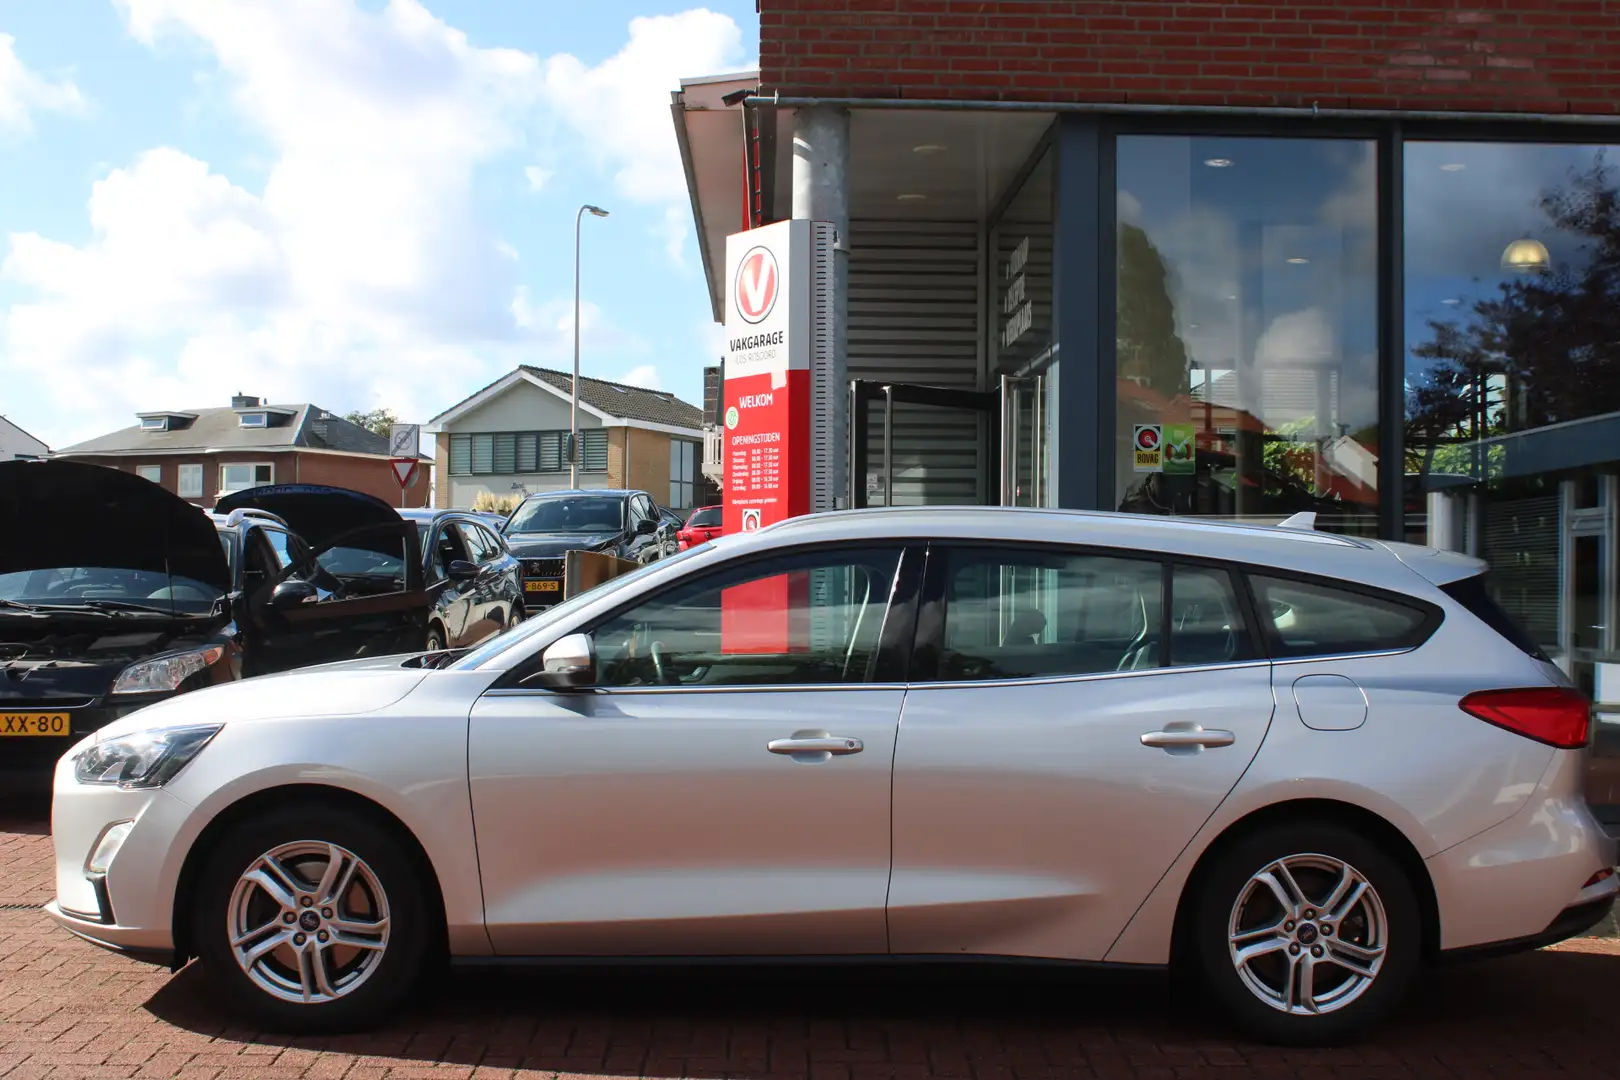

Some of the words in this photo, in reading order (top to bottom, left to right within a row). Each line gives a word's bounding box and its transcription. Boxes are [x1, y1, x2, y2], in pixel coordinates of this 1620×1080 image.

[730, 330, 784, 353] VAKGARAGE
[739, 392, 774, 409] WELKOM
[1136, 453, 1159, 464] BOVAG
[0, 715, 64, 733] XX-80
